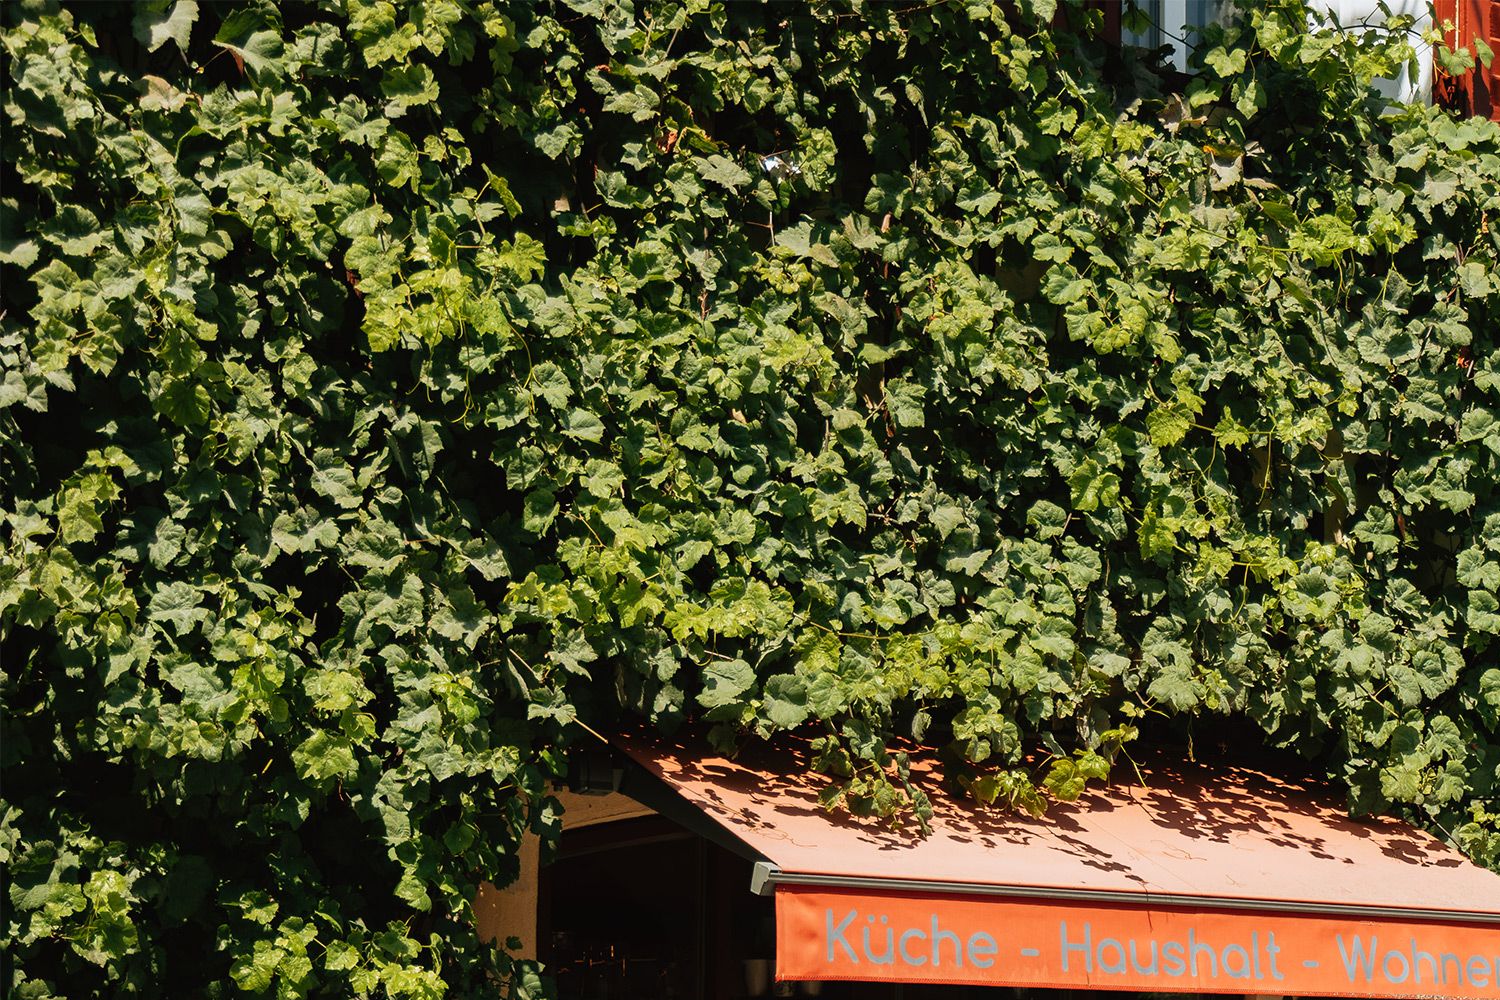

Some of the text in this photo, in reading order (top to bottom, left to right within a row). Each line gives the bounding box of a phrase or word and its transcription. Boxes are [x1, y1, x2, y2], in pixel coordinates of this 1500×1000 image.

[826, 908, 998, 968] Küche
[1021, 948, 1039, 957] -
[1060, 919, 1284, 980] Haushalt
[1302, 960, 1320, 968] -
